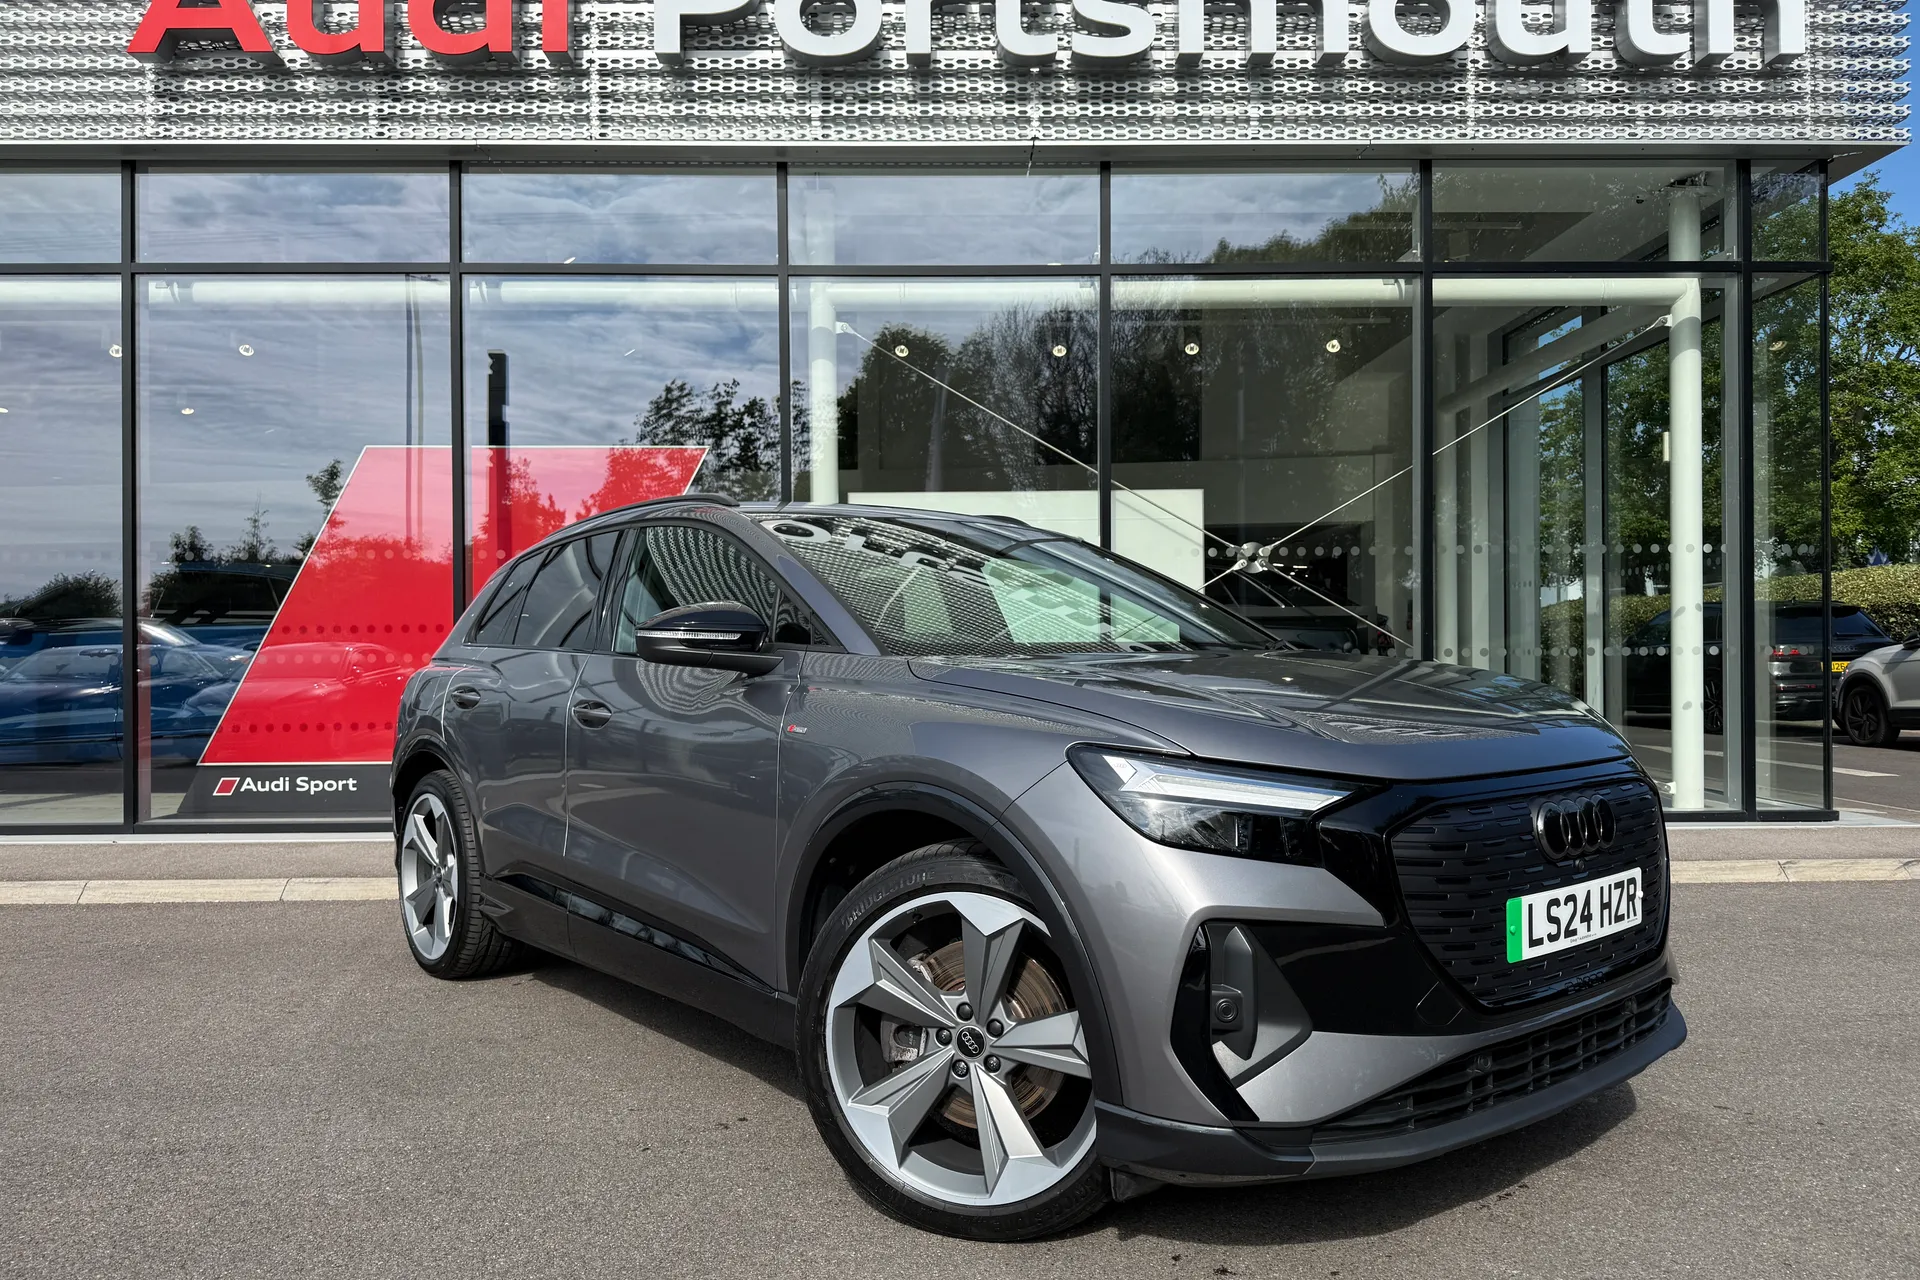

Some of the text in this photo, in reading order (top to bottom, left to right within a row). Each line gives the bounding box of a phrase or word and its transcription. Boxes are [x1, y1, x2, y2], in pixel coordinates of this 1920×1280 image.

[240, 776, 358, 795] Audi Sport
[1527, 876, 1638, 948] LS24 HZR
